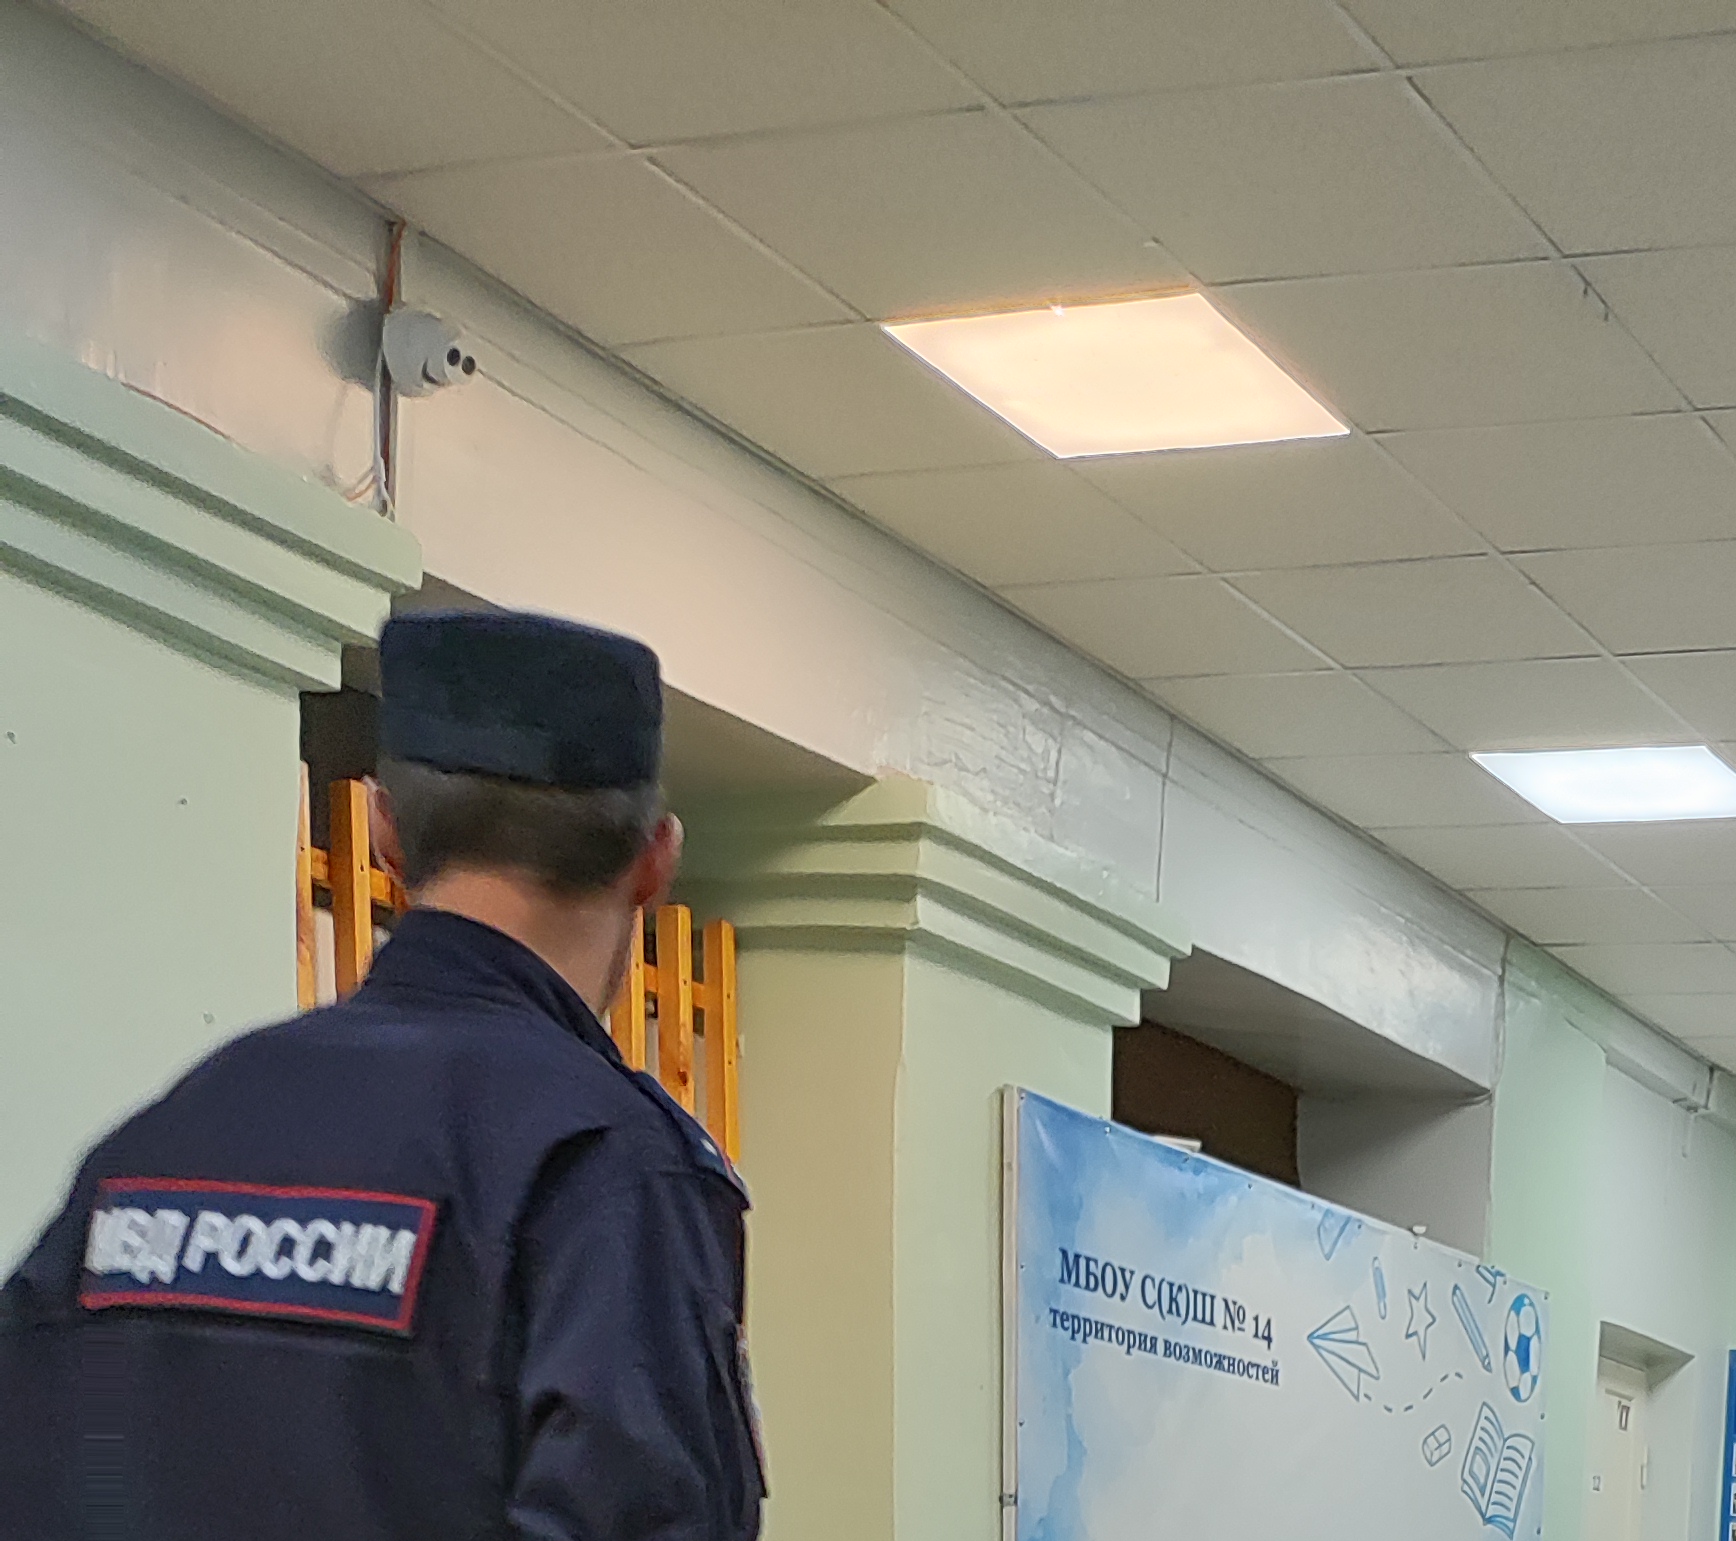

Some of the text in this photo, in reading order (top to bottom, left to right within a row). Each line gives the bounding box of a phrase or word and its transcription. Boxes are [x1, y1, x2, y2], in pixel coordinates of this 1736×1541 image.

[182, 1210, 417, 1296] РОССИИ
[1058, 1247, 1273, 1350] МБОУ С(К)Ш № 14
[1049, 1306, 1280, 1386] территория возможностей
